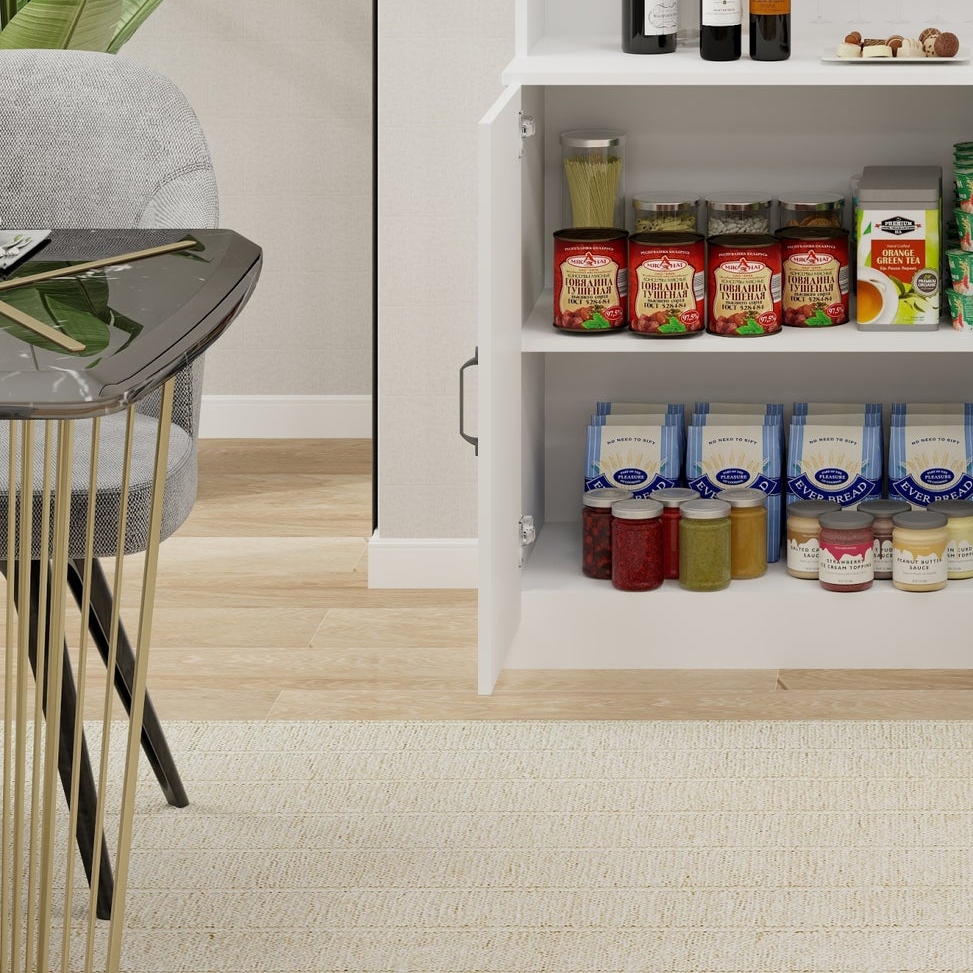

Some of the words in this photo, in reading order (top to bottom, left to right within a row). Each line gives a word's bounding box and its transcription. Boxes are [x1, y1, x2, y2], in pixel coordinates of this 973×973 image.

[882, 249, 914, 257] ORANGE
[565, 278, 613, 286] ГОВЯДИНА
[787, 276, 835, 284] ГОВЯДИНА
[641, 282, 689, 290] ГОВЯДИНА
[719, 284, 767, 292] ГОВЯДИНА
[790, 284, 833, 292] ТУШЕНАЯ
[567, 287, 611, 295] ТУШЕНАЯ
[643, 290, 687, 299] ТУШЕНАЯ
[722, 292, 765, 300] ТУШЕНАЯ
[828, 482, 867, 503] BREAD
[901, 481, 930, 503] EVER
